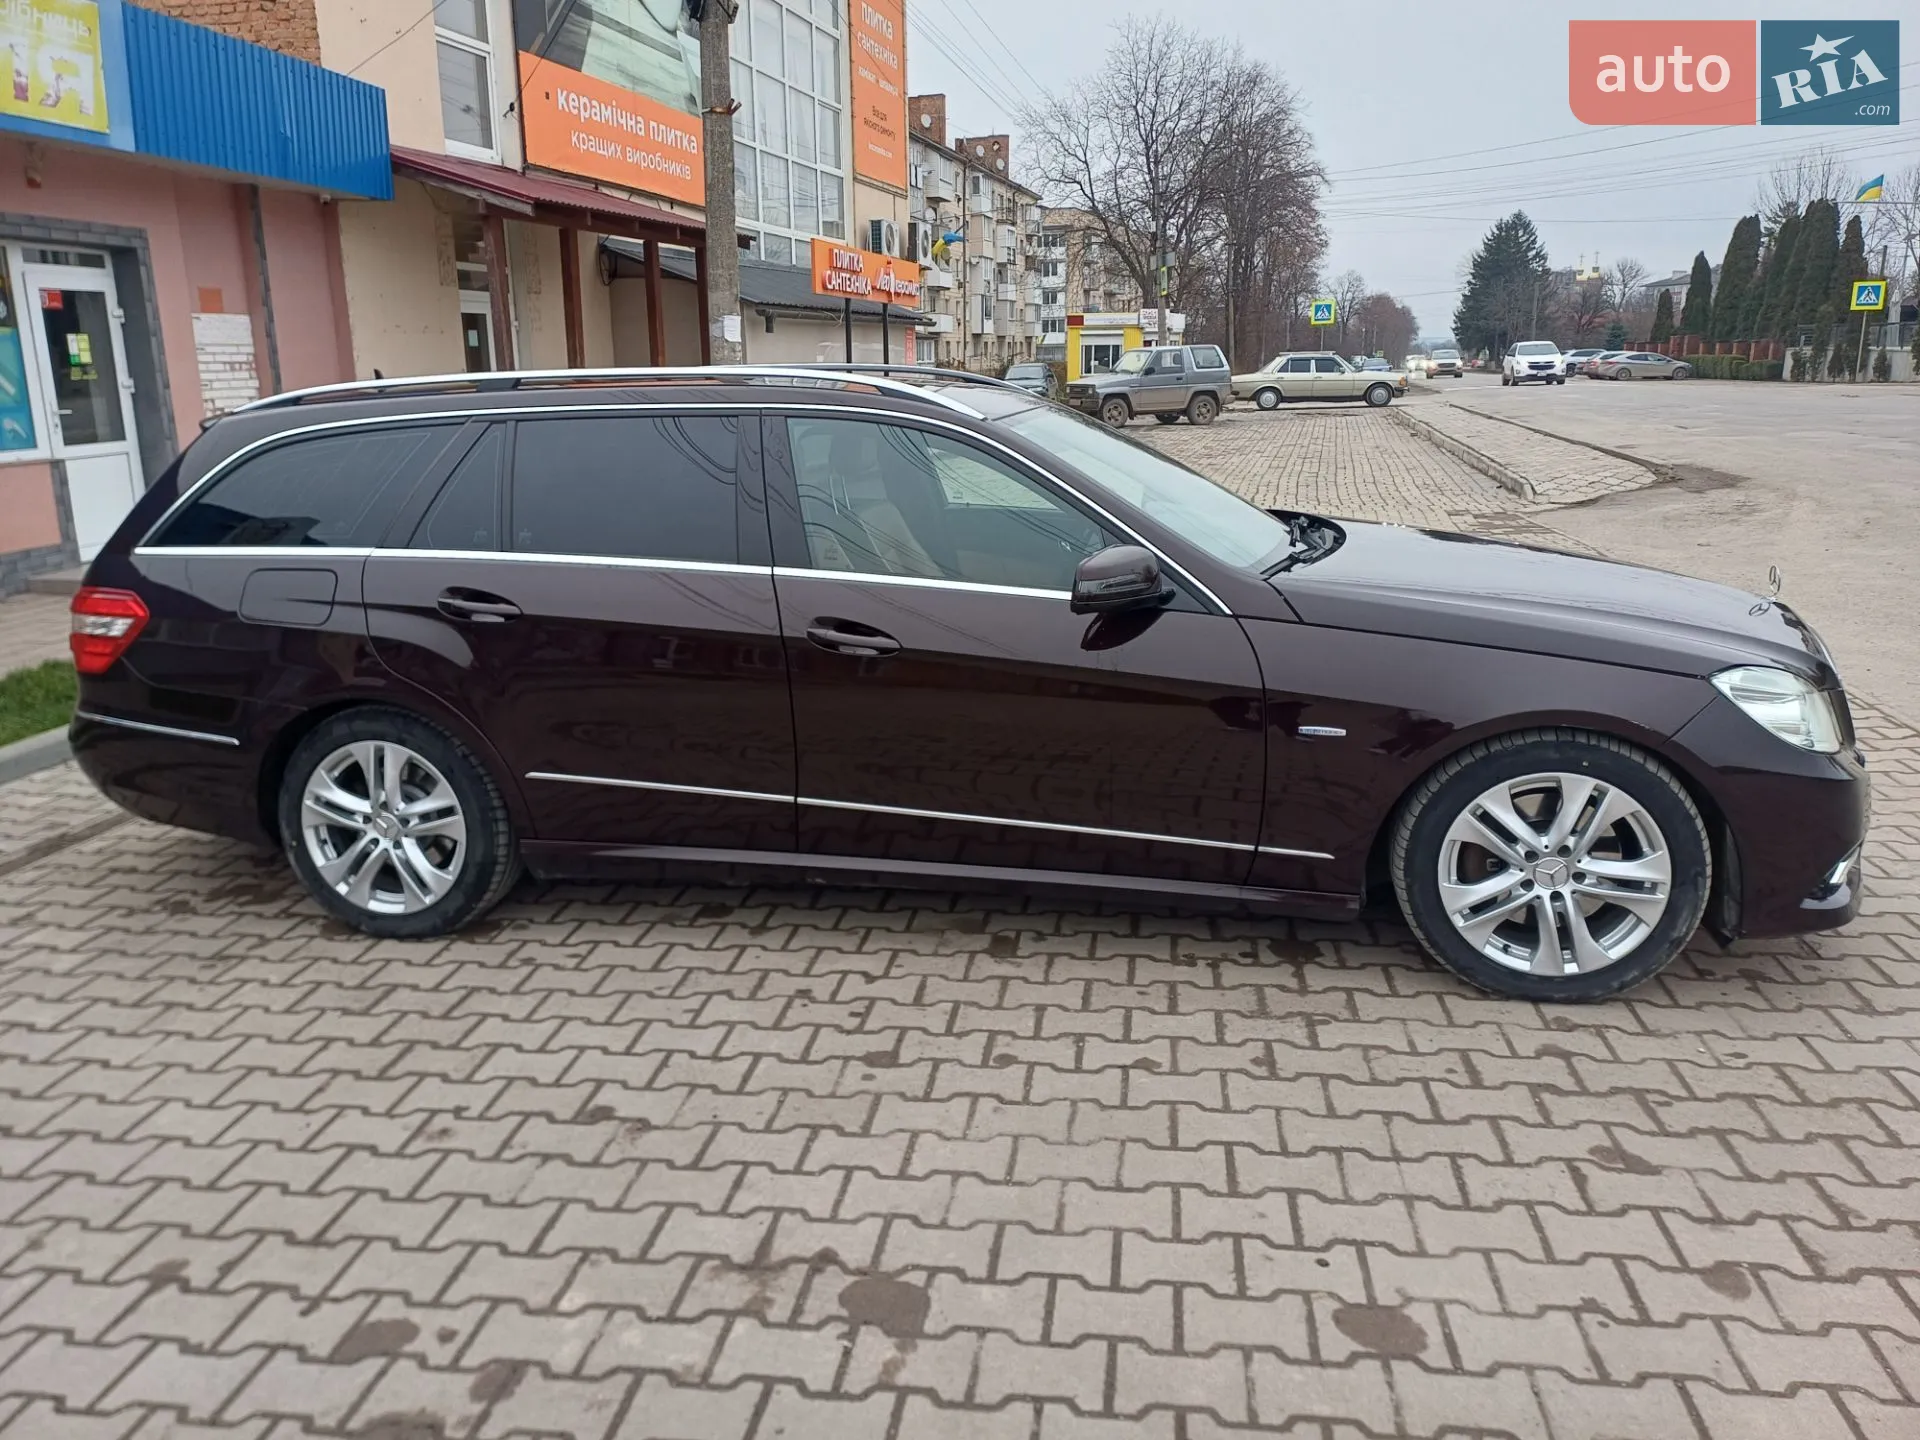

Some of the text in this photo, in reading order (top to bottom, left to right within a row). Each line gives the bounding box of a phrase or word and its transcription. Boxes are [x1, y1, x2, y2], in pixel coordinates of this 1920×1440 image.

[861, 1, 893, 40] плитка
[857, 31, 898, 71] сантехніка
[557, 88, 698, 155] керамічна плитка
[571, 130, 692, 180] кращих виробників
[832, 248, 864, 273] ПЛИТКА
[825, 270, 873, 295] САНТЕХНІКА
